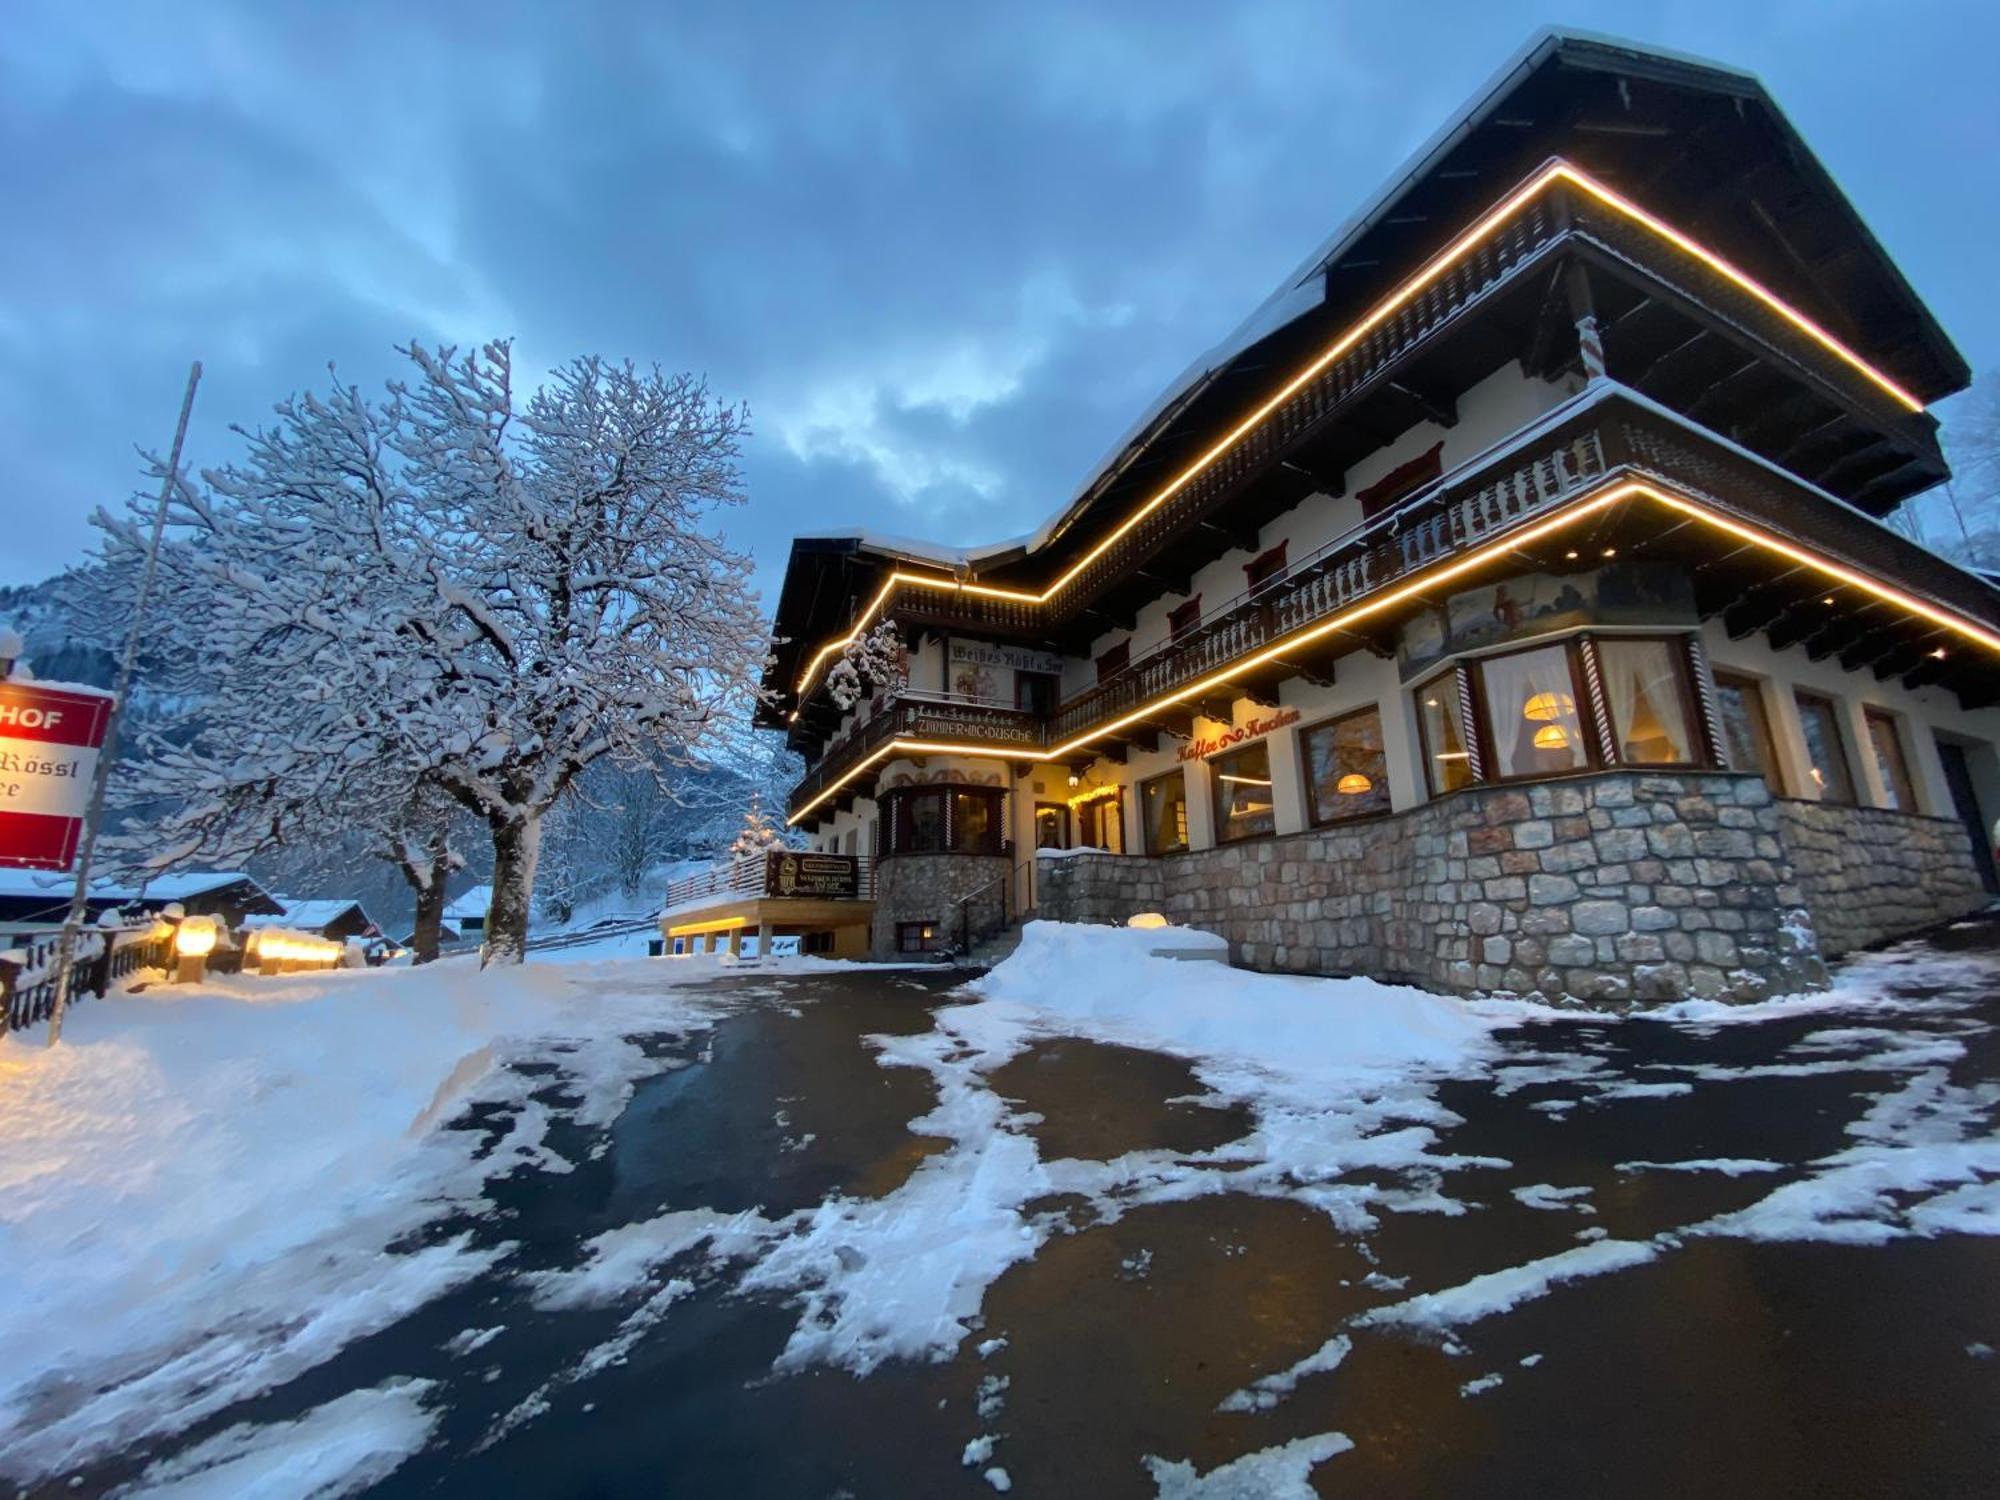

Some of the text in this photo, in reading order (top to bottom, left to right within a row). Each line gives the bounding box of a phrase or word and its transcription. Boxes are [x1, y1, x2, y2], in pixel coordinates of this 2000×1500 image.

[0, 705, 63, 729] HOF
[1177, 710, 1300, 762] Kaffee Kuchen
